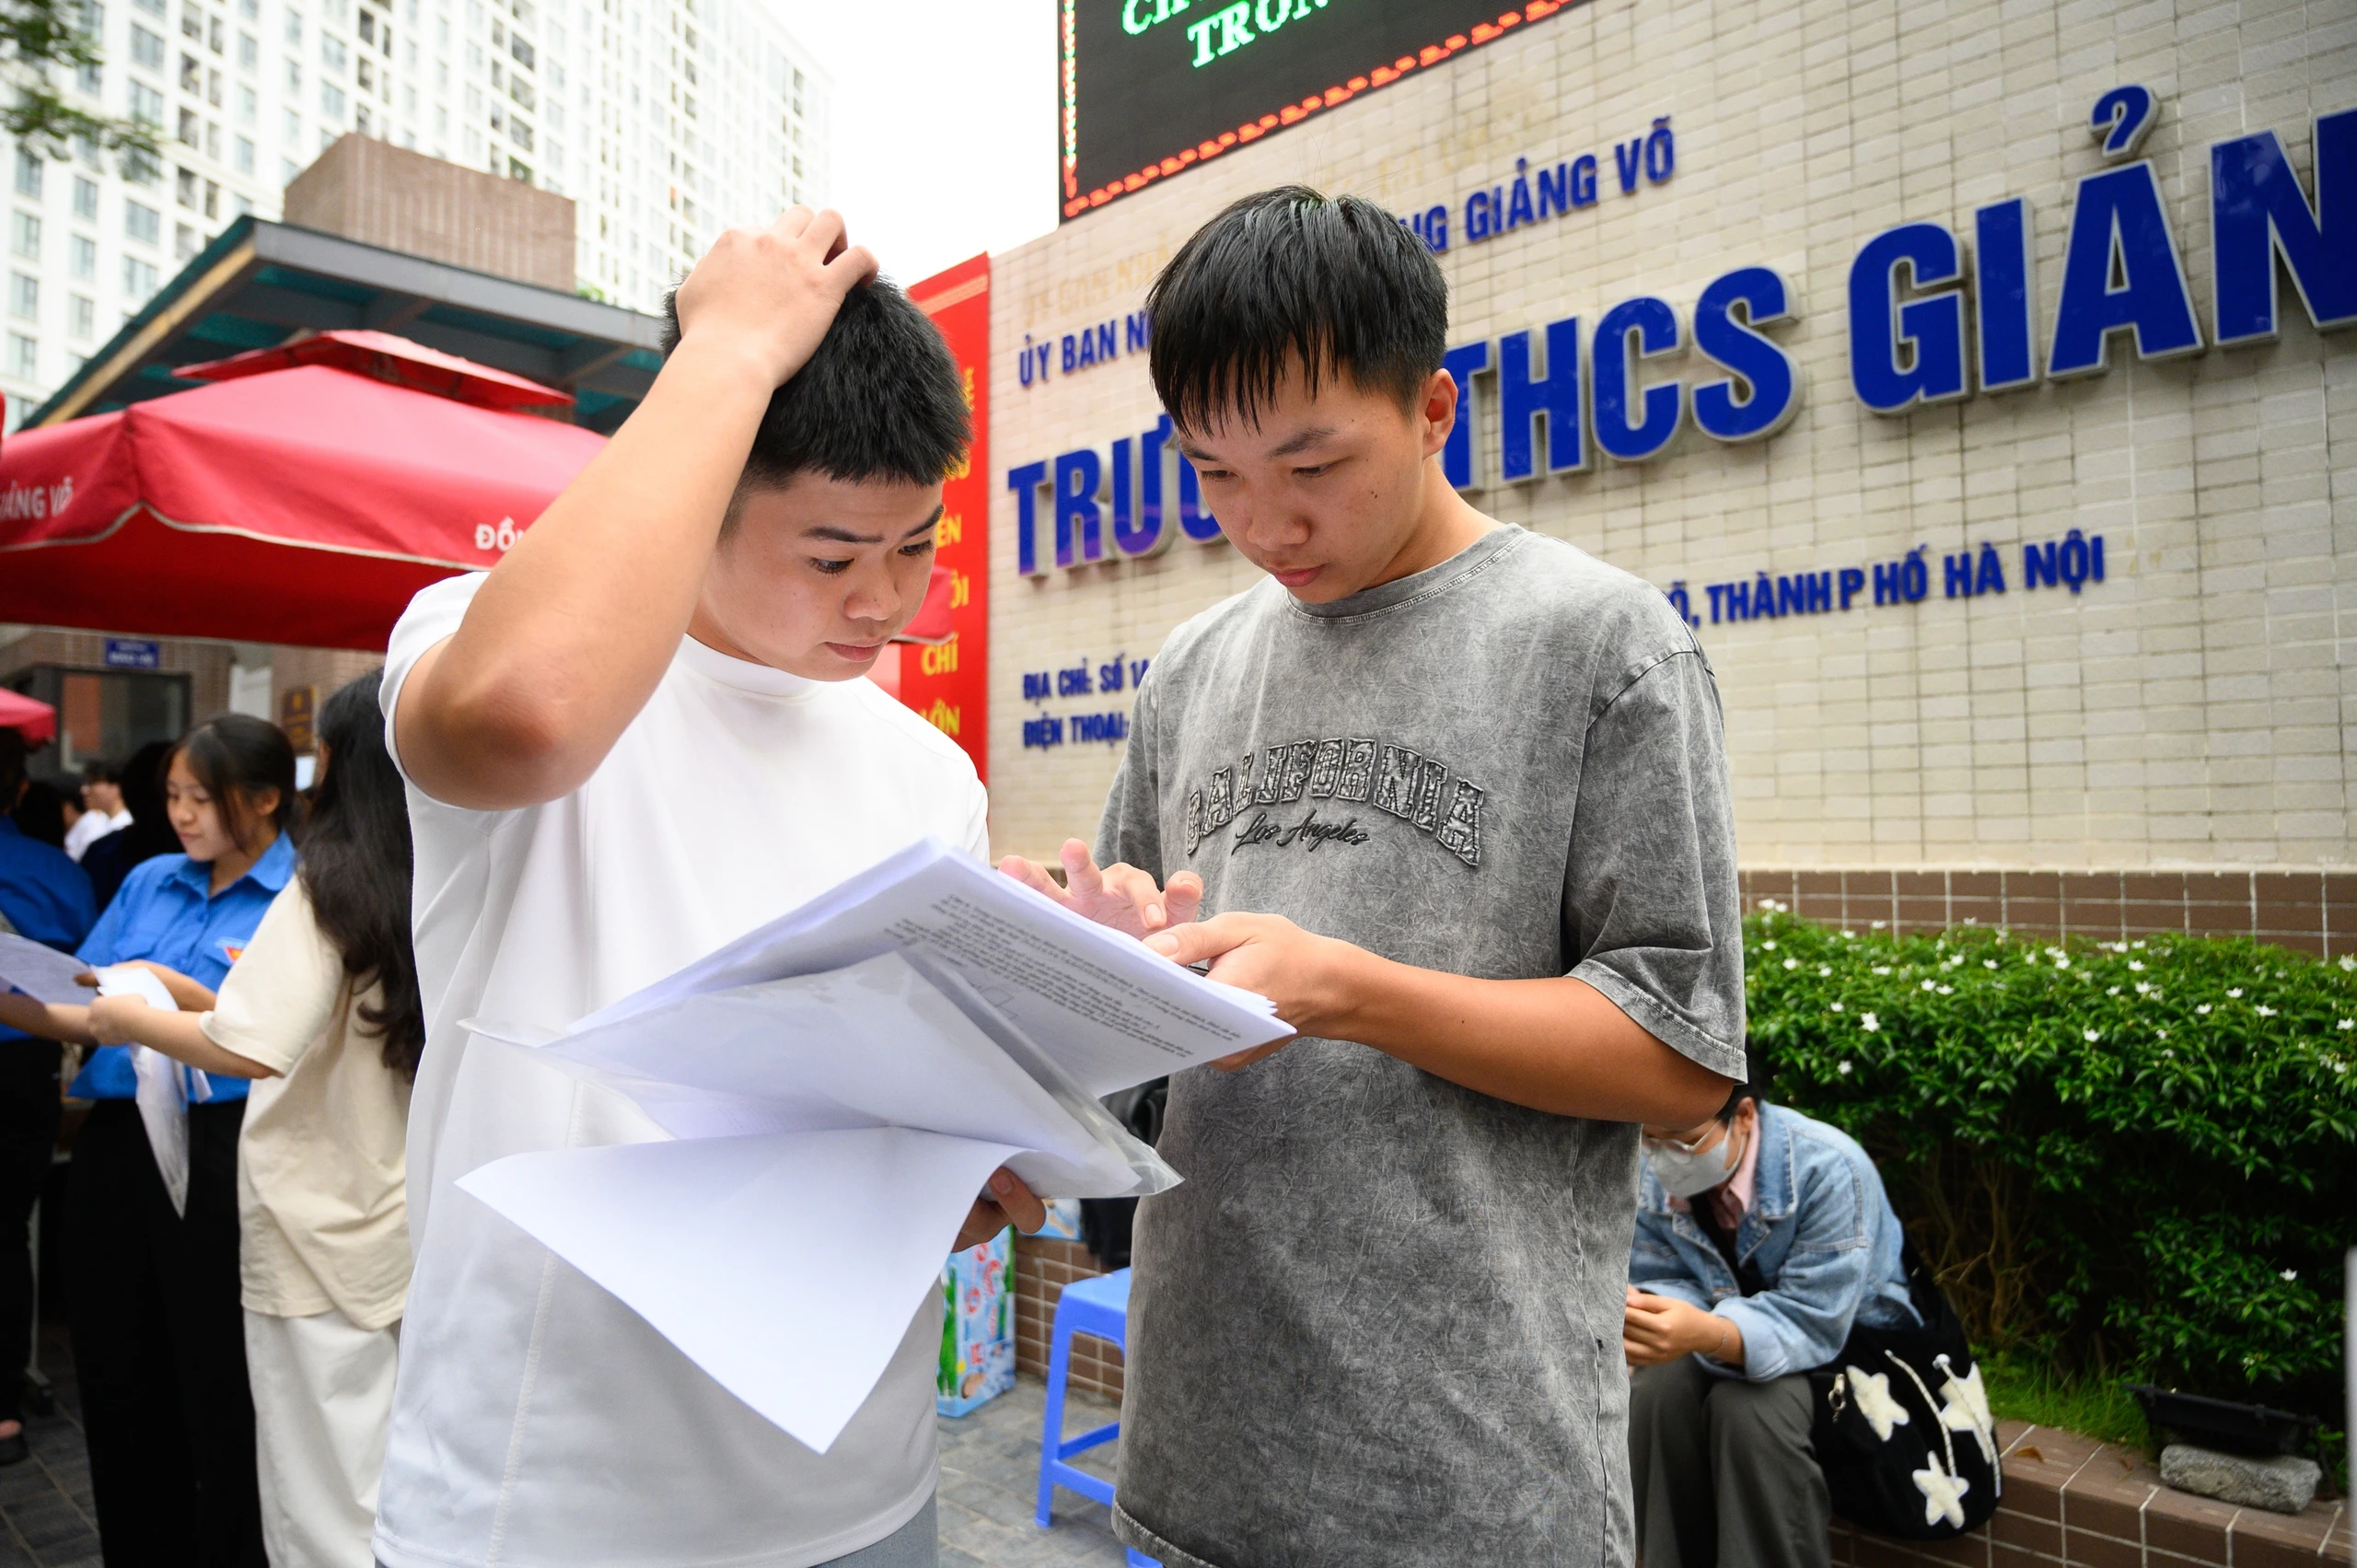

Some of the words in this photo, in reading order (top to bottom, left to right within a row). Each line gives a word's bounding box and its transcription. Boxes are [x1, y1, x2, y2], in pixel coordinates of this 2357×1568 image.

[1019, 335, 1051, 388] ỦY
[1062, 319, 1116, 373] BAN
[1126, 308, 1154, 354] N
[1465, 157, 1598, 243] GIẢNG
[1615, 115, 1676, 195] VÕ
[1443, 266, 1801, 491] THCS
[1099, 652, 1125, 694] SỐ
[1704, 571, 1832, 624] THÀNH
[1944, 541, 2006, 598] HÀ
[2024, 528, 2106, 595] NỘI
[1186, 737, 1486, 868] CALIFORNIA
[1231, 812, 1282, 855] Los
[1276, 808, 1371, 853] Angeles
